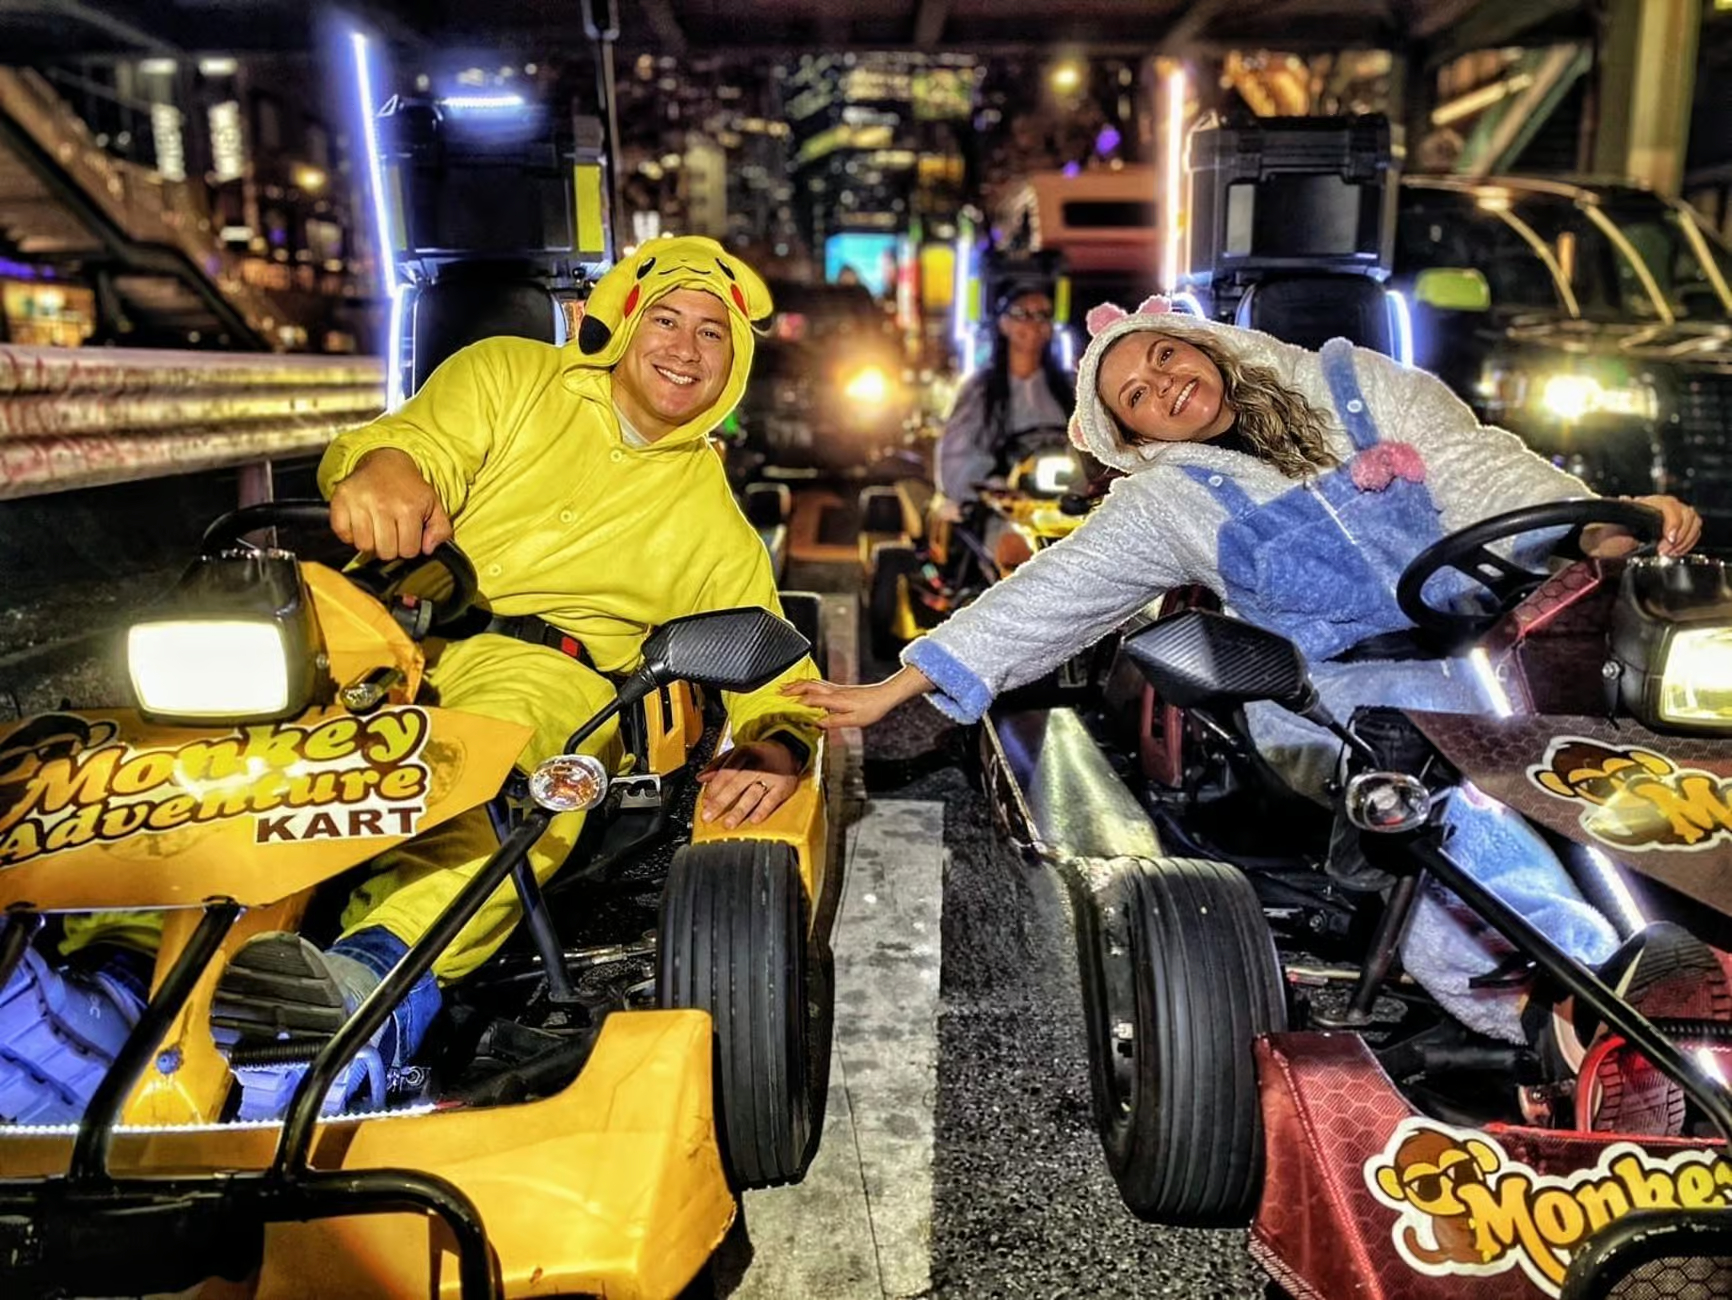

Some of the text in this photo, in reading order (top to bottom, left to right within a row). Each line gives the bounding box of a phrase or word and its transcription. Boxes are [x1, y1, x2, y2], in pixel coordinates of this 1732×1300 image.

[0, 707, 427, 834] Monkey
[0, 764, 427, 865] Adventure
[257, 807, 422, 842] KART
